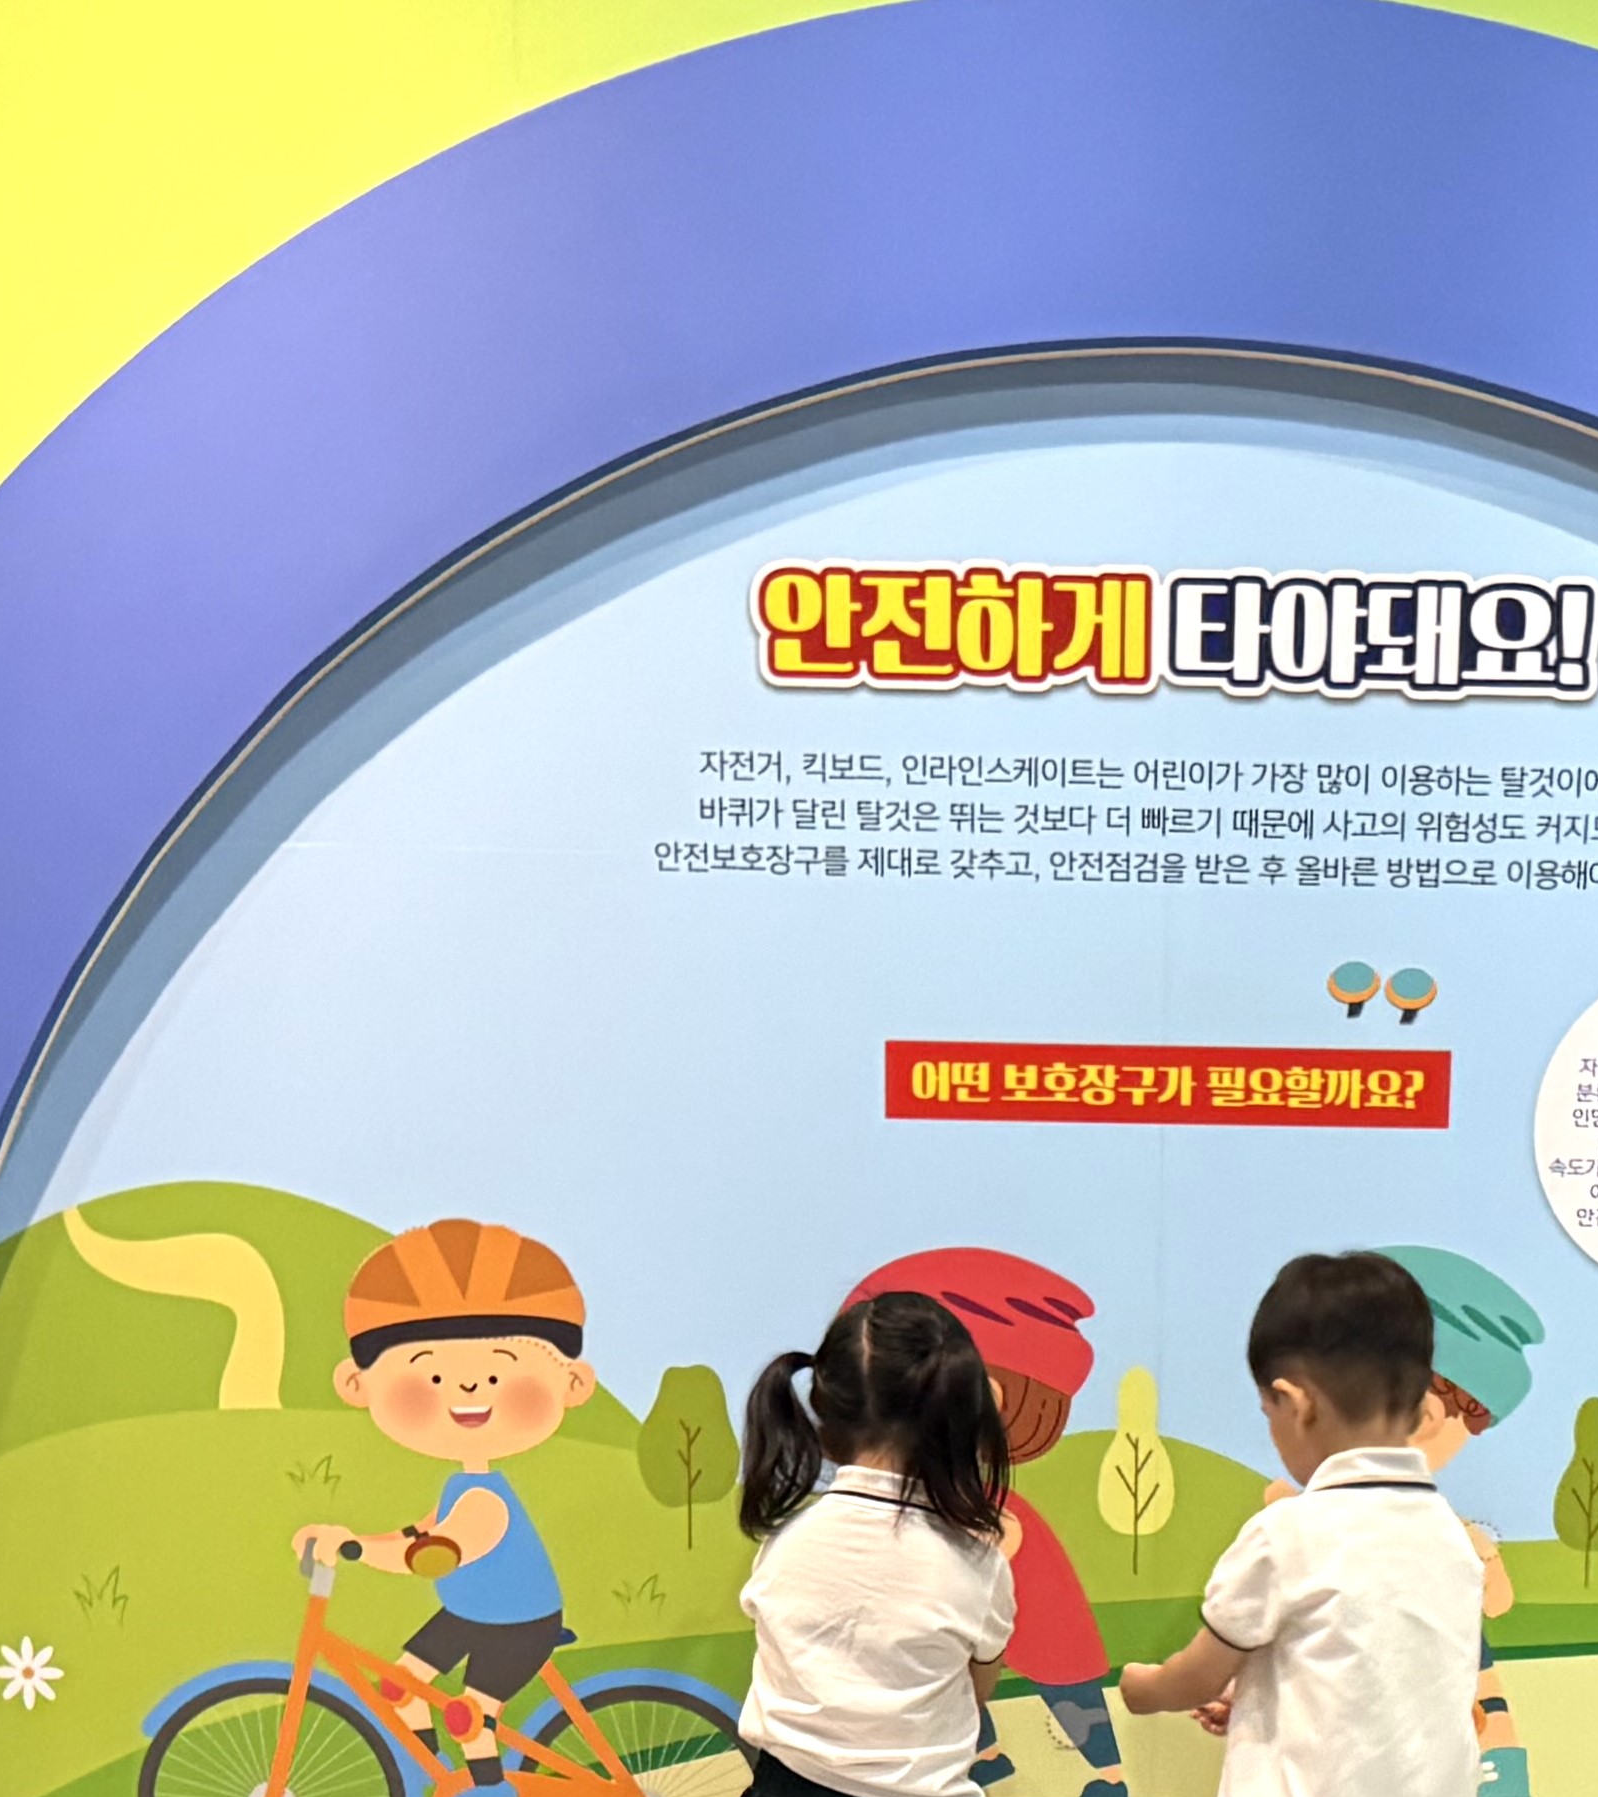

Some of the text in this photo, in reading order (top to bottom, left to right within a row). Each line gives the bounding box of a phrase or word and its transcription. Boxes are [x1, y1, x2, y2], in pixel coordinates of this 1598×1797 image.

[764, 572, 1595, 686] 안전하게 타야돼요!
[699, 750, 791, 786] 자전거,
[803, 752, 891, 788] 킥보드,
[902, 754, 1125, 789] 인라인스케이트는
[1134, 759, 1244, 792] 어린이가
[1251, 762, 1309, 794] 가장
[1317, 763, 1369, 796] 많이
[1381, 764, 1493, 797] 이용하는
[700, 796, 785, 830] 바퀴가
[792, 798, 846, 830] 달린
[857, 800, 941, 832] 탈것은
[949, 802, 1005, 834] 뛰는
[1014, 803, 1098, 836] 것보다
[1106, 805, 1130, 838] 더
[1141, 805, 1221, 839] 빠르기
[1233, 808, 1314, 840] 때문에
[1322, 809, 1406, 842] 사고의
[1415, 811, 1527, 844] 위험성도
[654, 841, 850, 877] 안전보호장구를
[857, 846, 942, 878] 제대로
[950, 848, 1040, 882] 갖추고,
[1049, 850, 1187, 884] 안전점검을
[1195, 853, 1251, 884] 받은
[1258, 854, 1288, 886] 후
[1295, 855, 1379, 887] 올바른
[1387, 857, 1498, 888] 방법으로
[911, 1060, 1425, 1110] 어떤 보호장구가 필요할까요?
